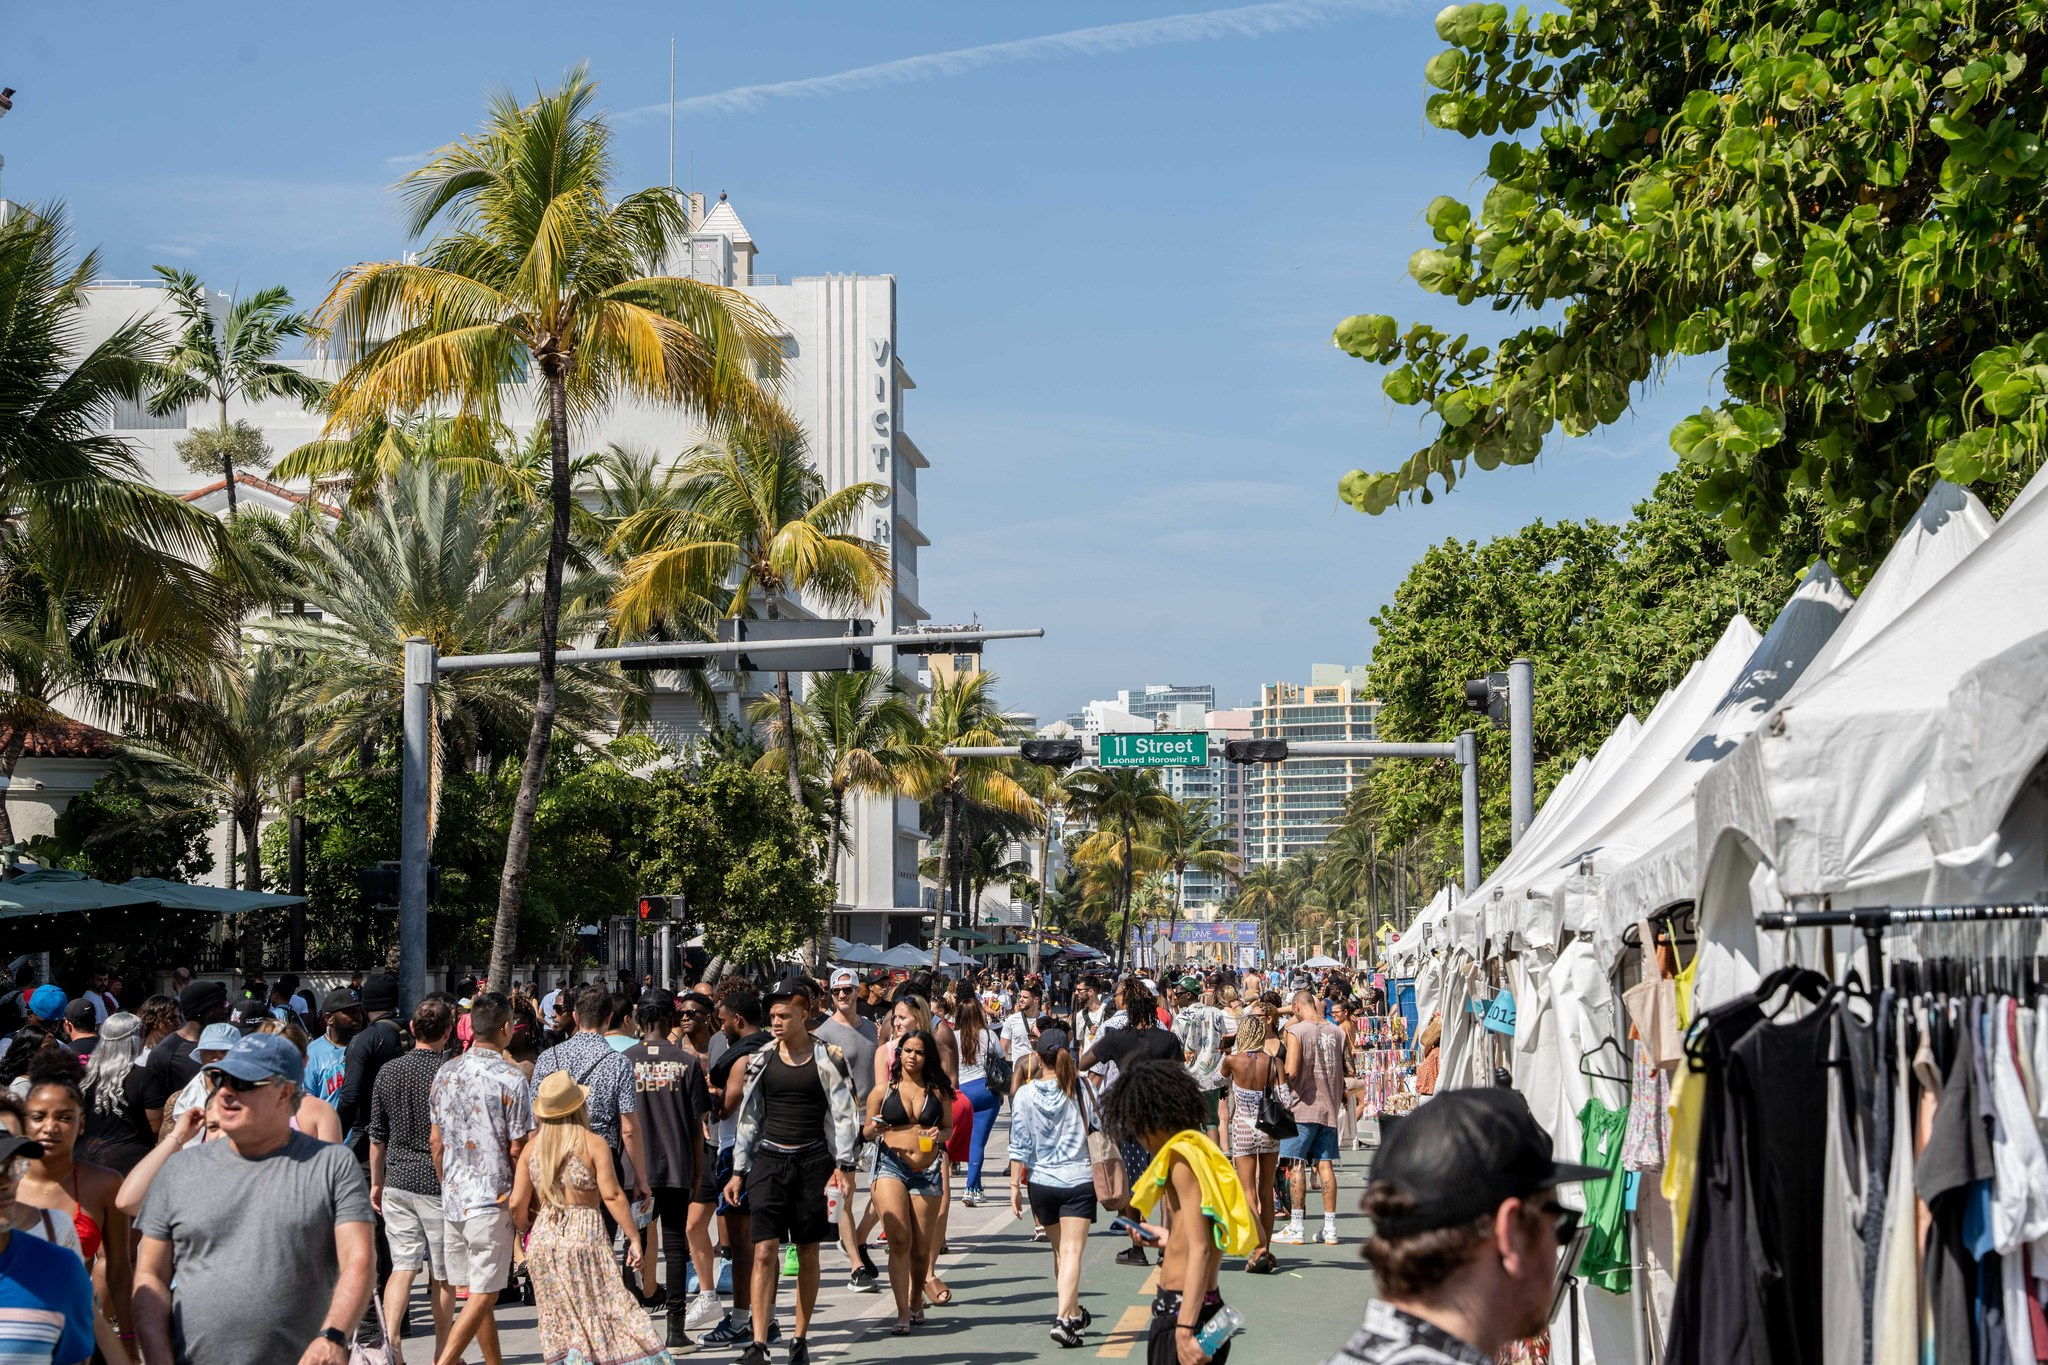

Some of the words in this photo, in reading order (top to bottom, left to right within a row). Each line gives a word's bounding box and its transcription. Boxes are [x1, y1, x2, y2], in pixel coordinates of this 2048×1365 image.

[1114, 736, 1127, 756] 11
[1135, 738, 1193, 754] Street
[1107, 756, 1145, 764] Leonard
[1148, 755, 1188, 763] Horowitz
[1191, 755, 1200, 763] Pl
